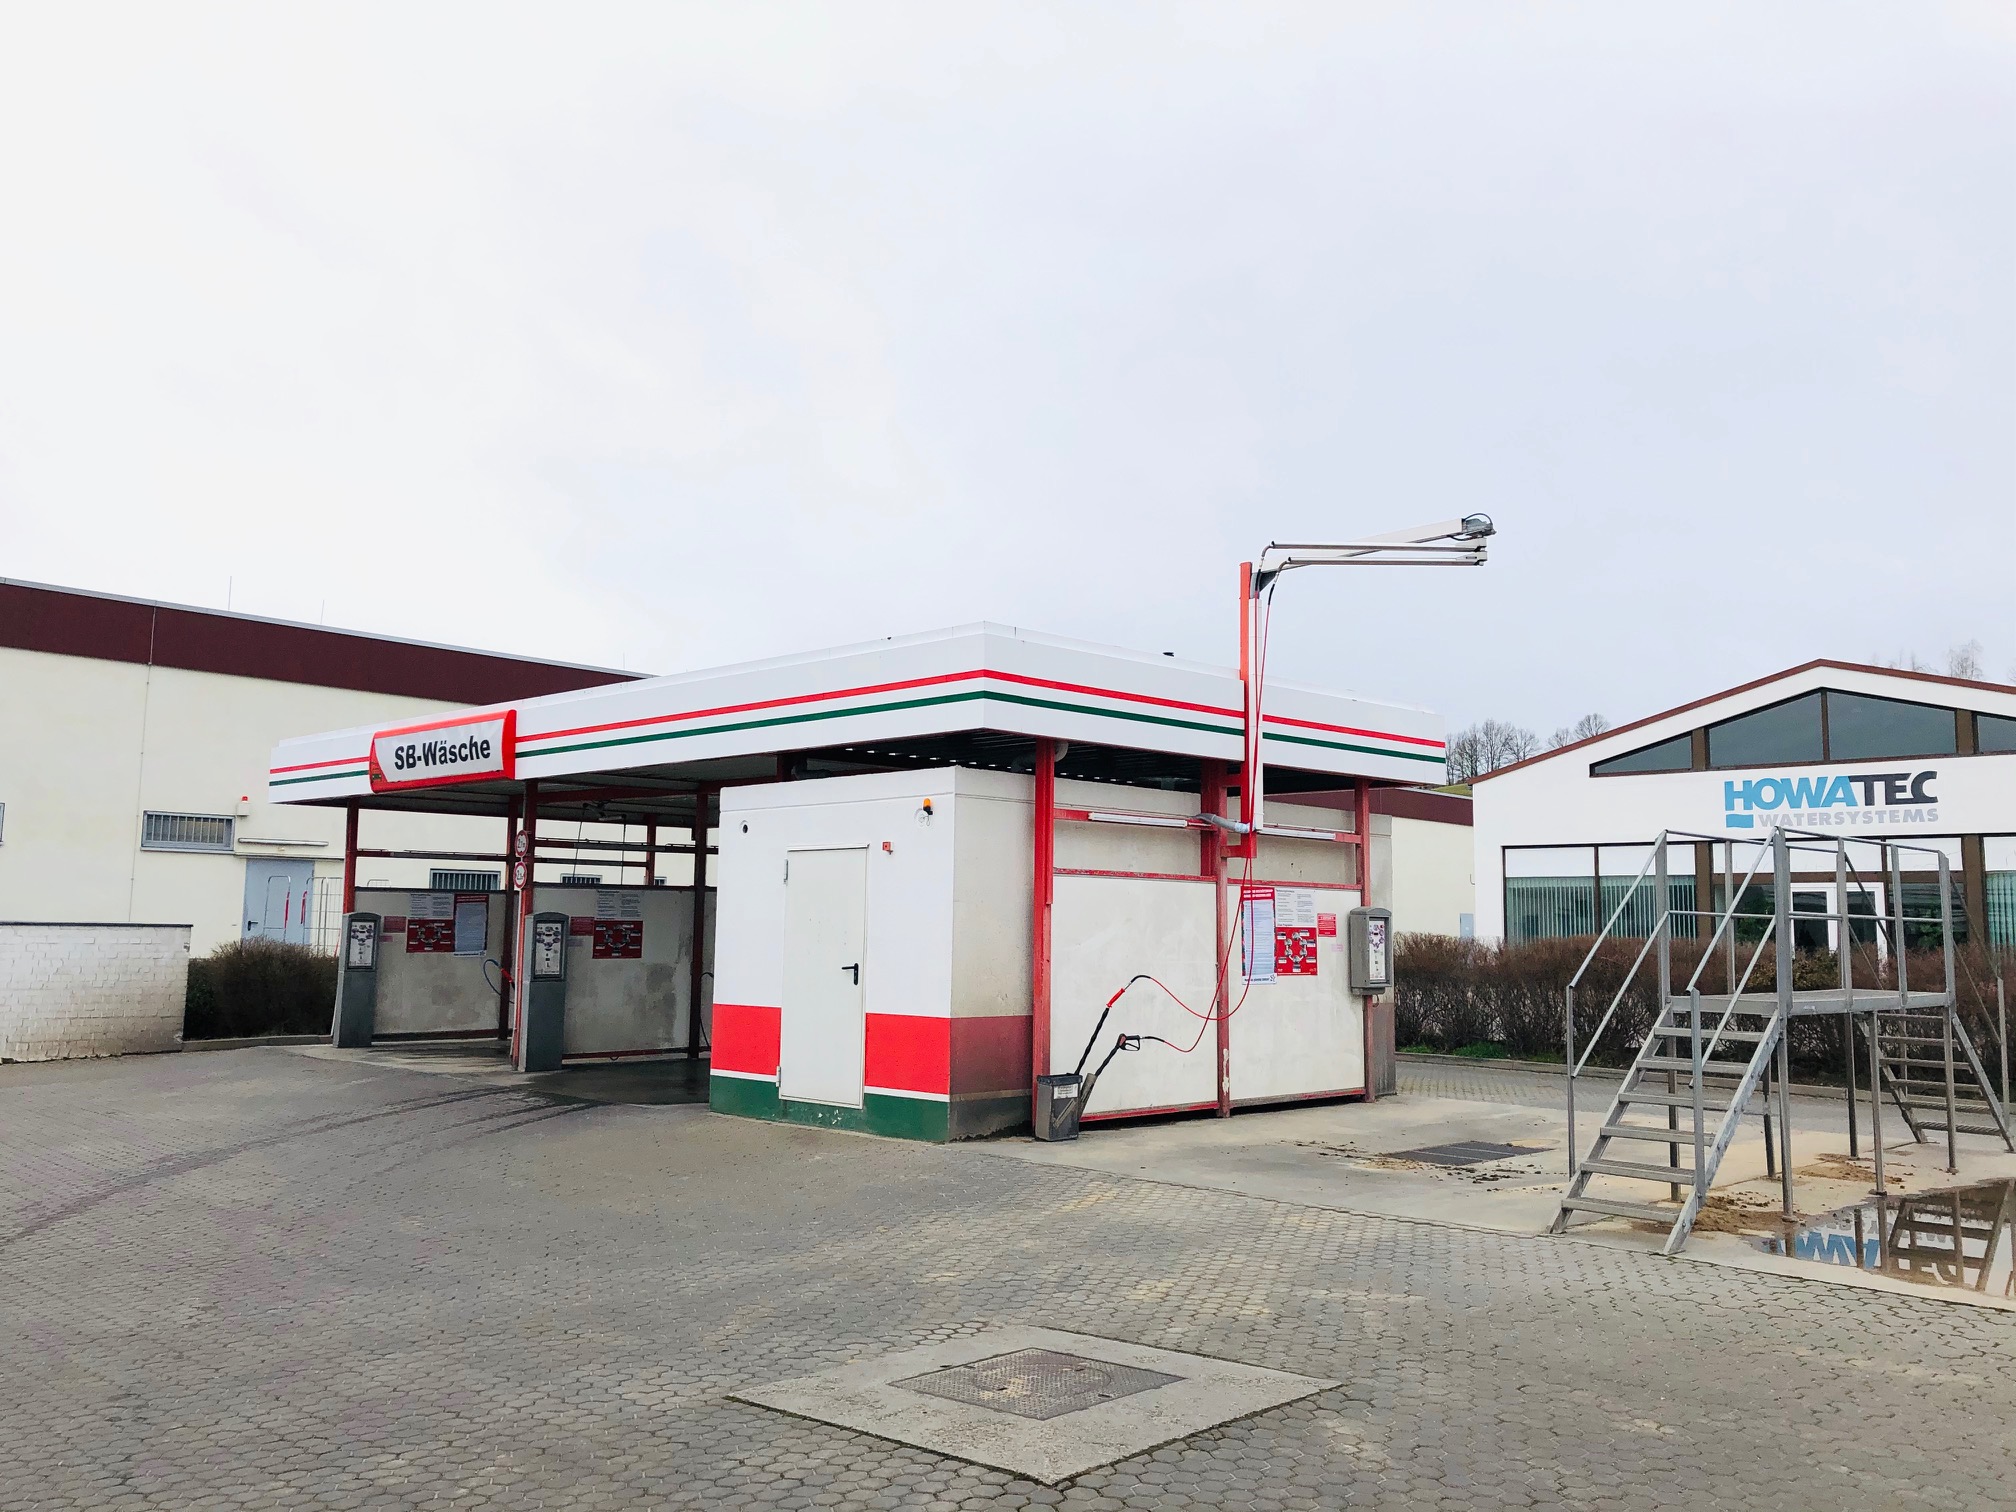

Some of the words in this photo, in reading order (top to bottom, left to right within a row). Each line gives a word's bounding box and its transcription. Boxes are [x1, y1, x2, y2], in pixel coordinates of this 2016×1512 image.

[394, 735, 491, 770] SB-Wäsche
[1724, 770, 1938, 811] HOWATEC
[1758, 808, 1938, 828] WATERSYSTEMS
